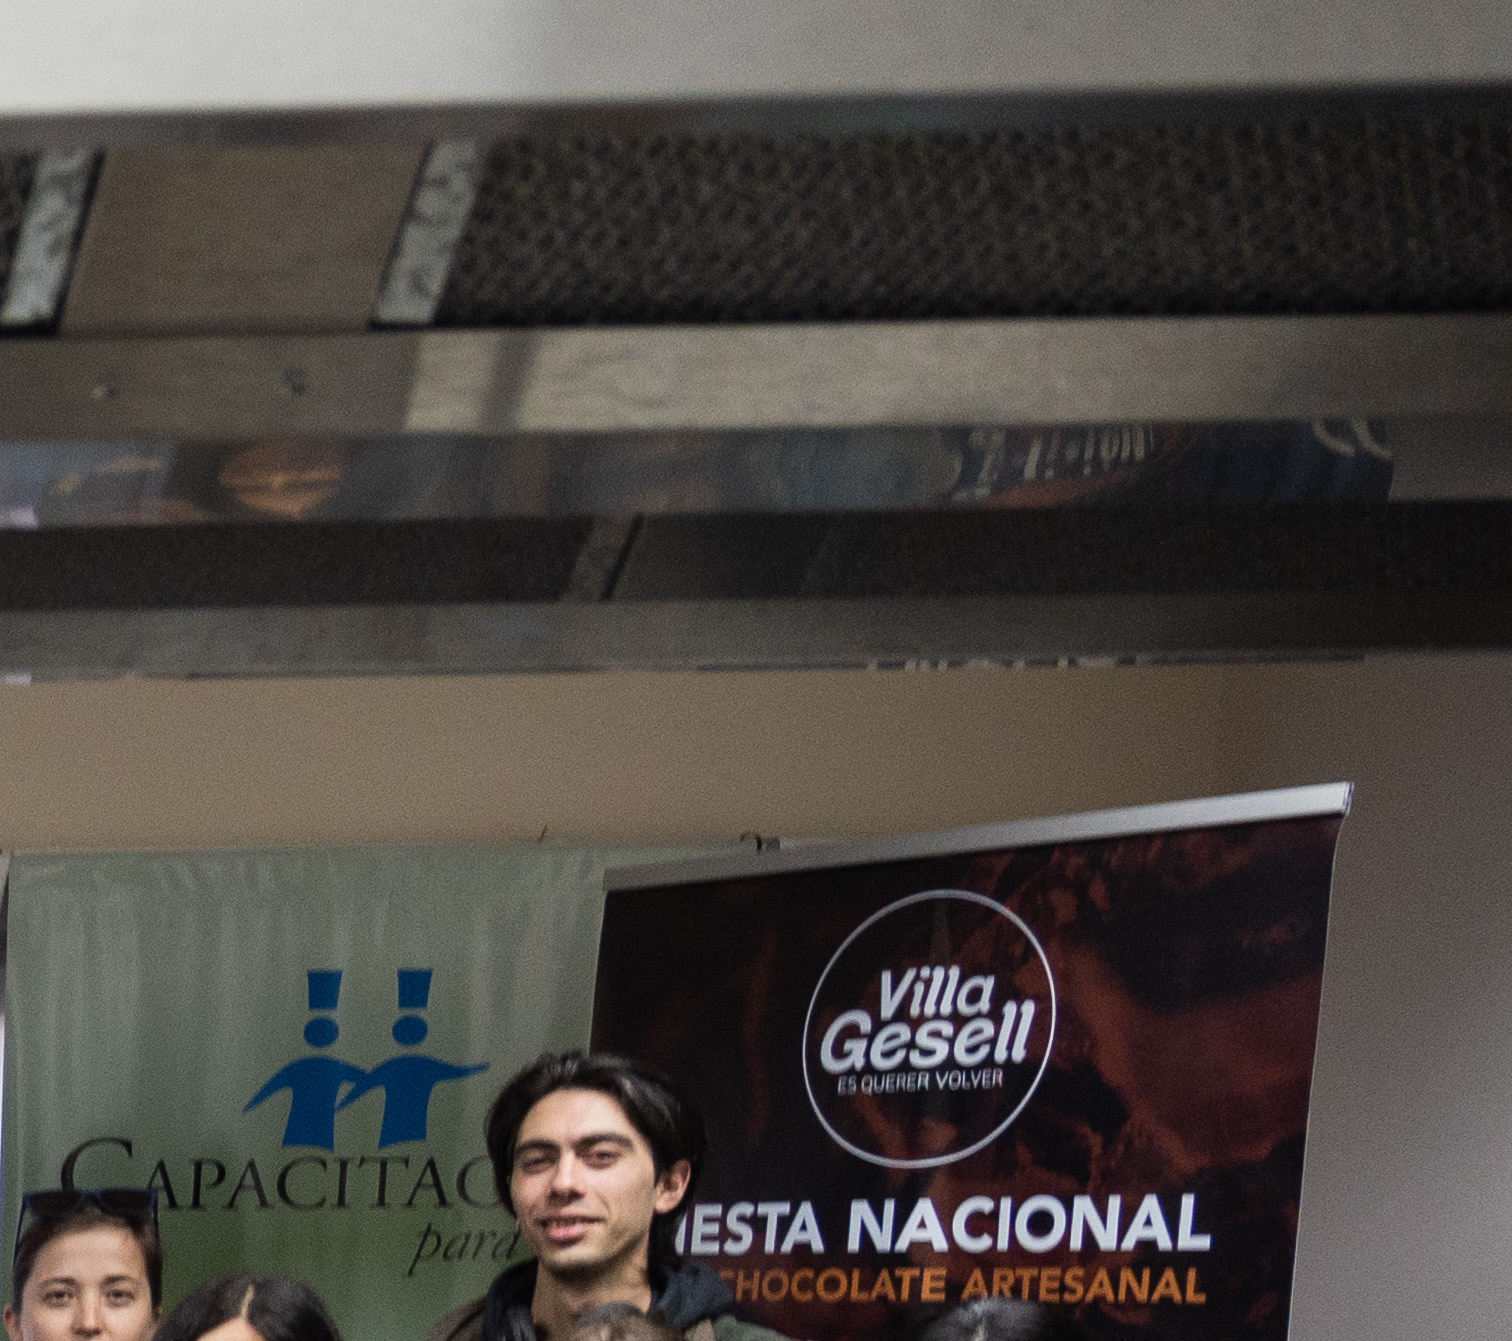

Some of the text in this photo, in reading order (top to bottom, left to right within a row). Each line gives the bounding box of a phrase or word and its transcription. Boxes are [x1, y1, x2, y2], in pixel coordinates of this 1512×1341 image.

[880, 965, 995, 1021] Villa
[820, 1000, 1035, 1076] Gesell
[837, 1067, 1004, 1096] ES QUERER VOLVER
[61, 1137, 505, 1211] CAPACITAC
[406, 1222, 520, 1277] para
[675, 1192, 1211, 1257] IESTA NACIONAL
[720, 1265, 1207, 1304] HOCOLATE ARTESANAL
